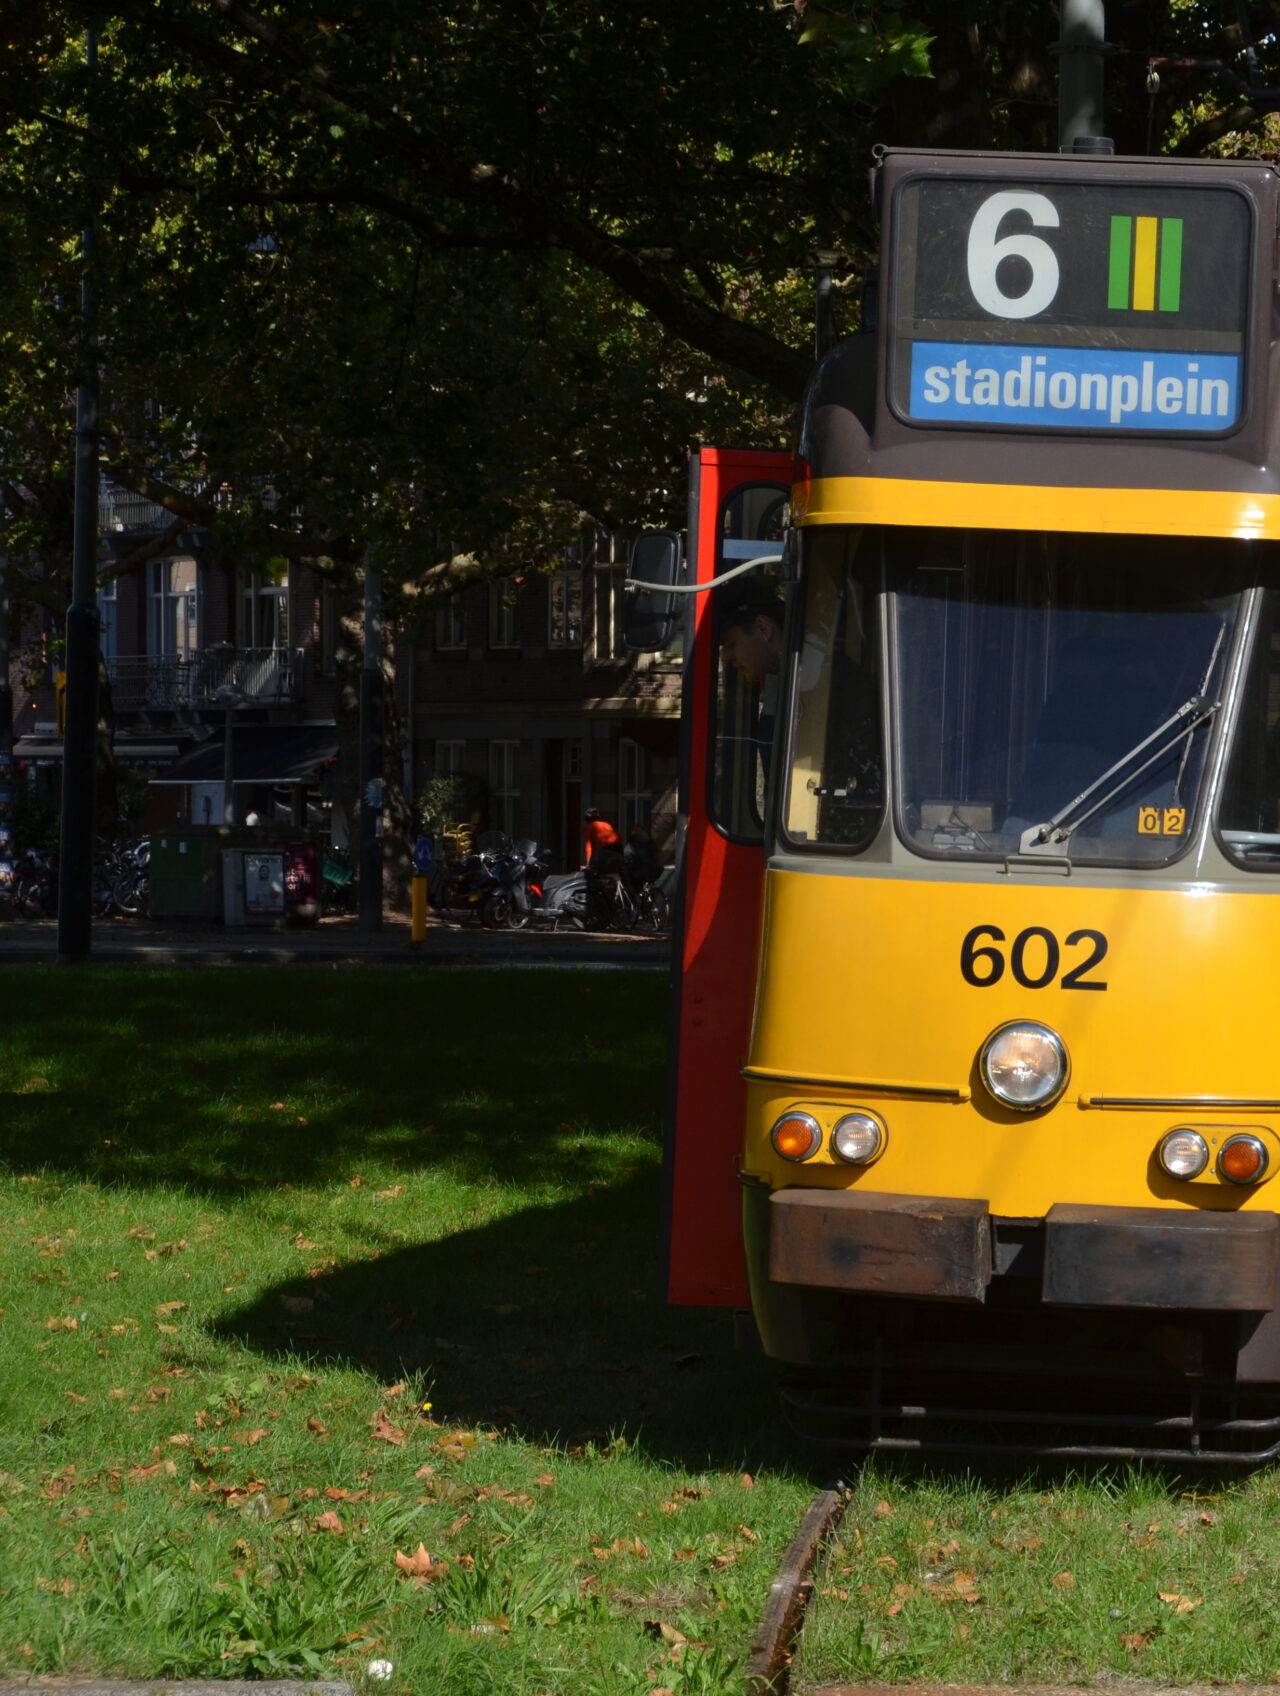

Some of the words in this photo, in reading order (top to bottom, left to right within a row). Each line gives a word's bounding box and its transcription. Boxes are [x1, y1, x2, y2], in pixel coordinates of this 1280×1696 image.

[967, 189, 1060, 319] 6
[923, 355, 1229, 423] stadionplein
[960, 924, 1108, 991] 602
